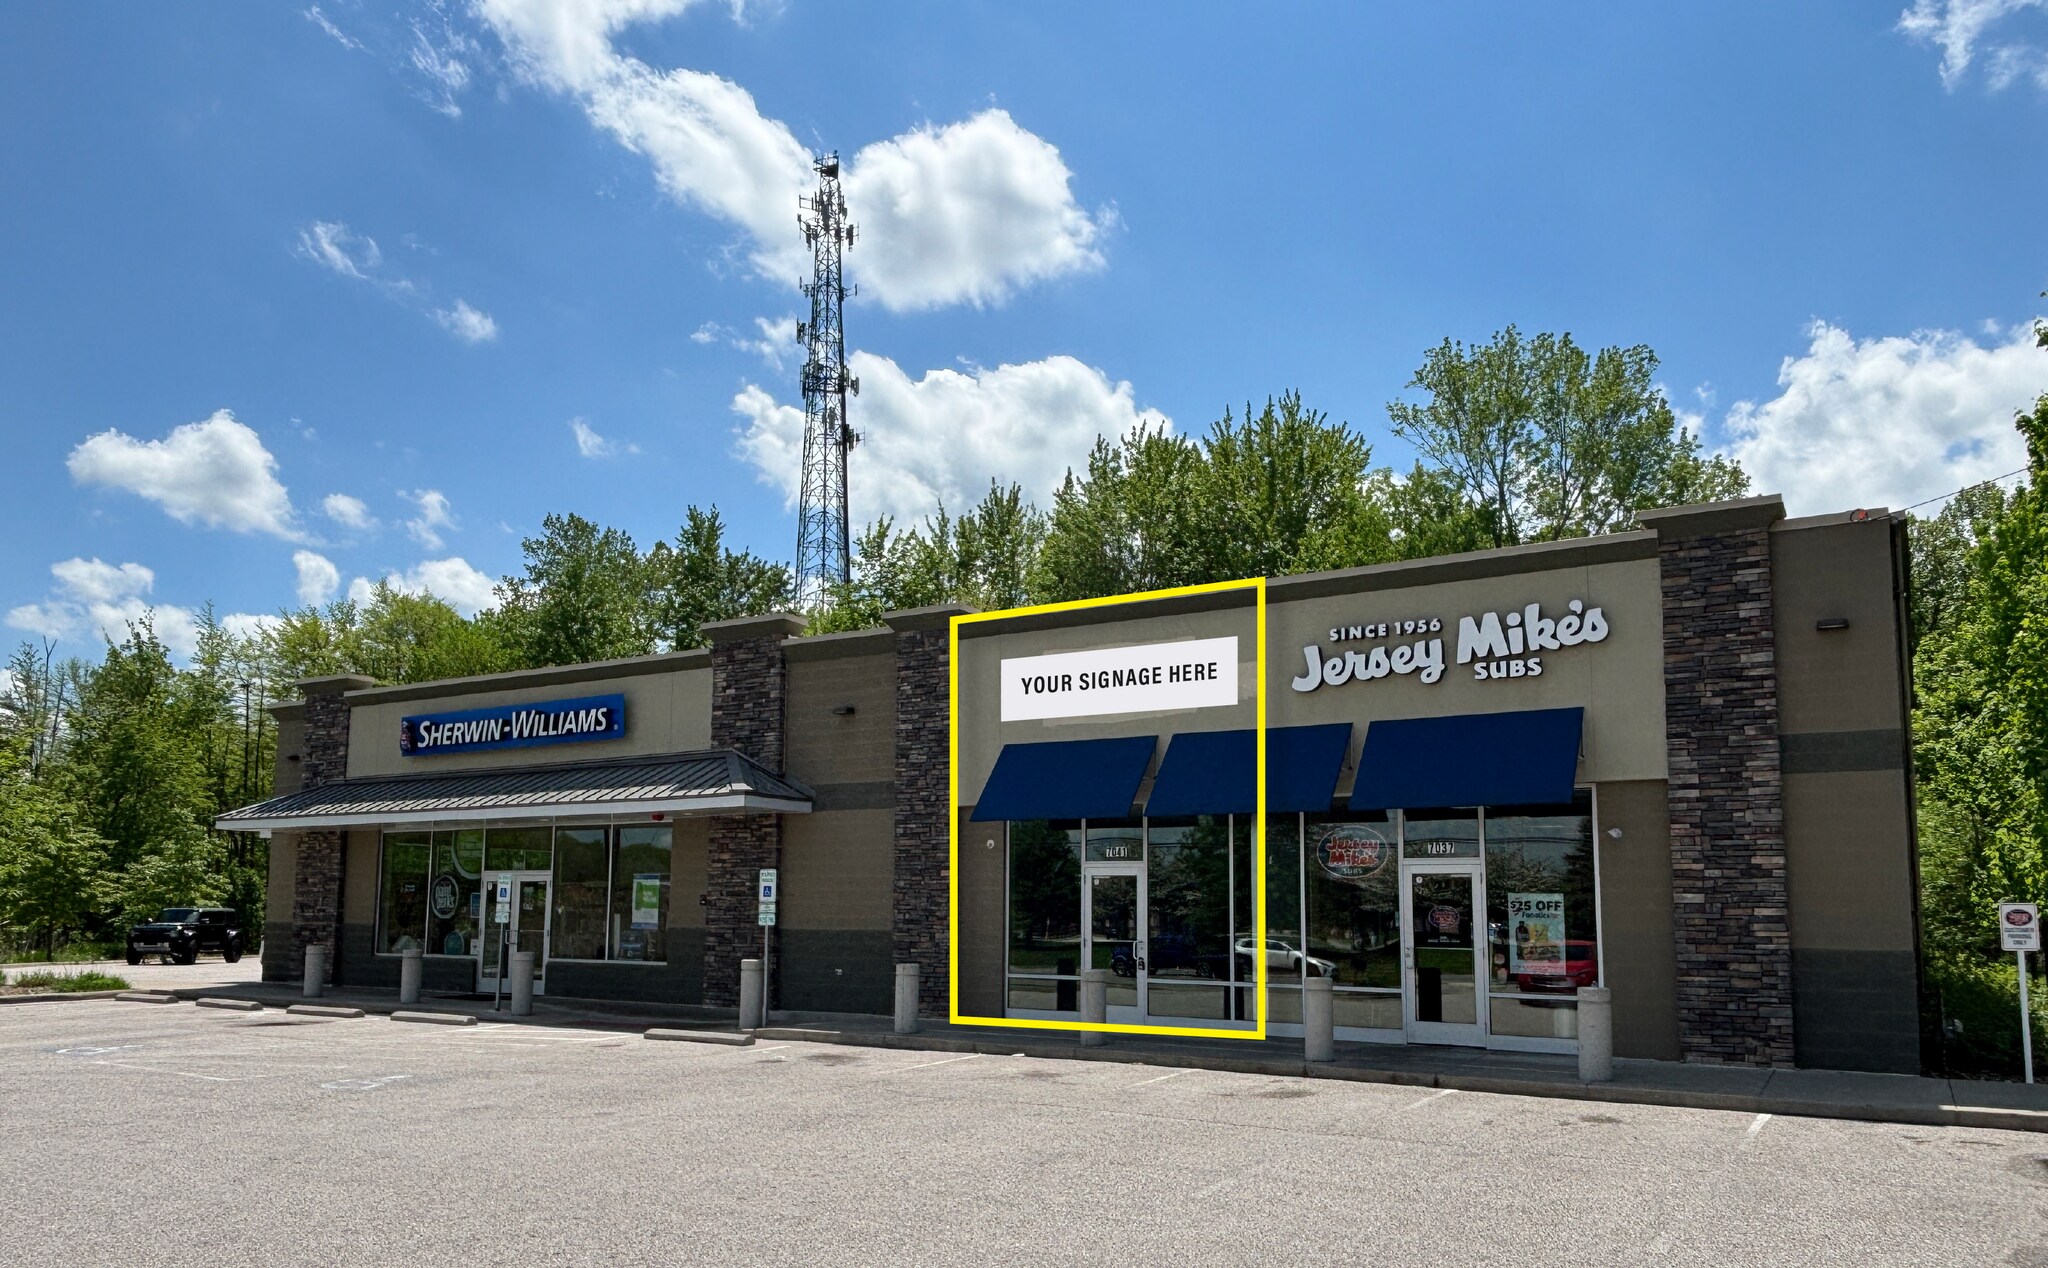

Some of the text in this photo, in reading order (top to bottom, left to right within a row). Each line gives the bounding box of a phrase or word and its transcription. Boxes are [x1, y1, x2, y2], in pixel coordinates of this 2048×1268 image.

[1329, 617, 1442, 642] SINCE 1956
[1291, 599, 1609, 692] Jersey Mike's
[1474, 657, 1543, 680] SUBS
[417, 707, 607, 748] SHERWIN-WILLIAMS
[1428, 842, 1454, 854] 7037
[1510, 899, 1562, 912] $25 OFF
